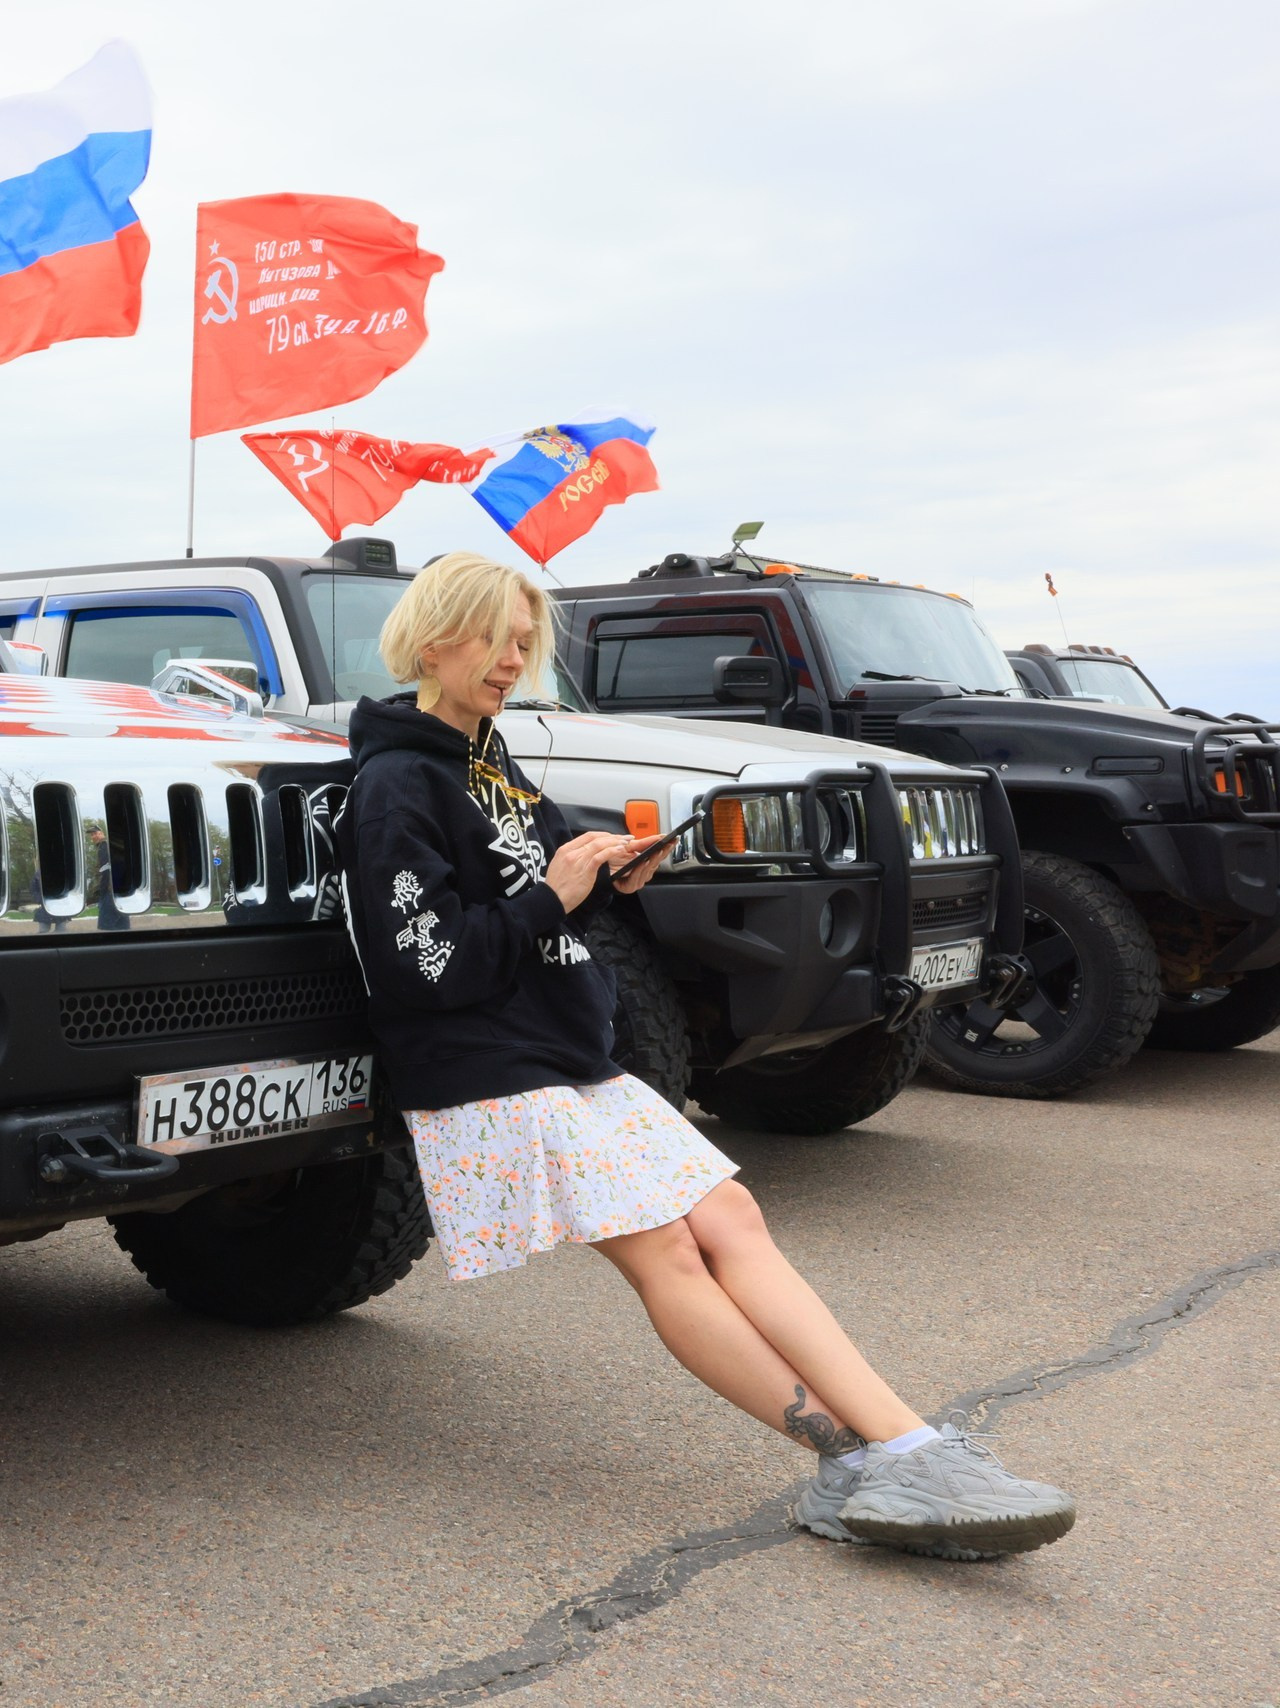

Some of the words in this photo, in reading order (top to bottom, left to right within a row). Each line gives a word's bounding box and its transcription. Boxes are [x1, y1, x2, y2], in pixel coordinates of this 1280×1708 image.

[255, 240, 277, 263] 150
[279, 239, 303, 259] СТР.
[266, 314, 290, 354] 79
[316, 1055, 365, 1100] 136
[321, 1096, 348, 1114] RUS
[210, 1117, 309, 1144] HUMMER
